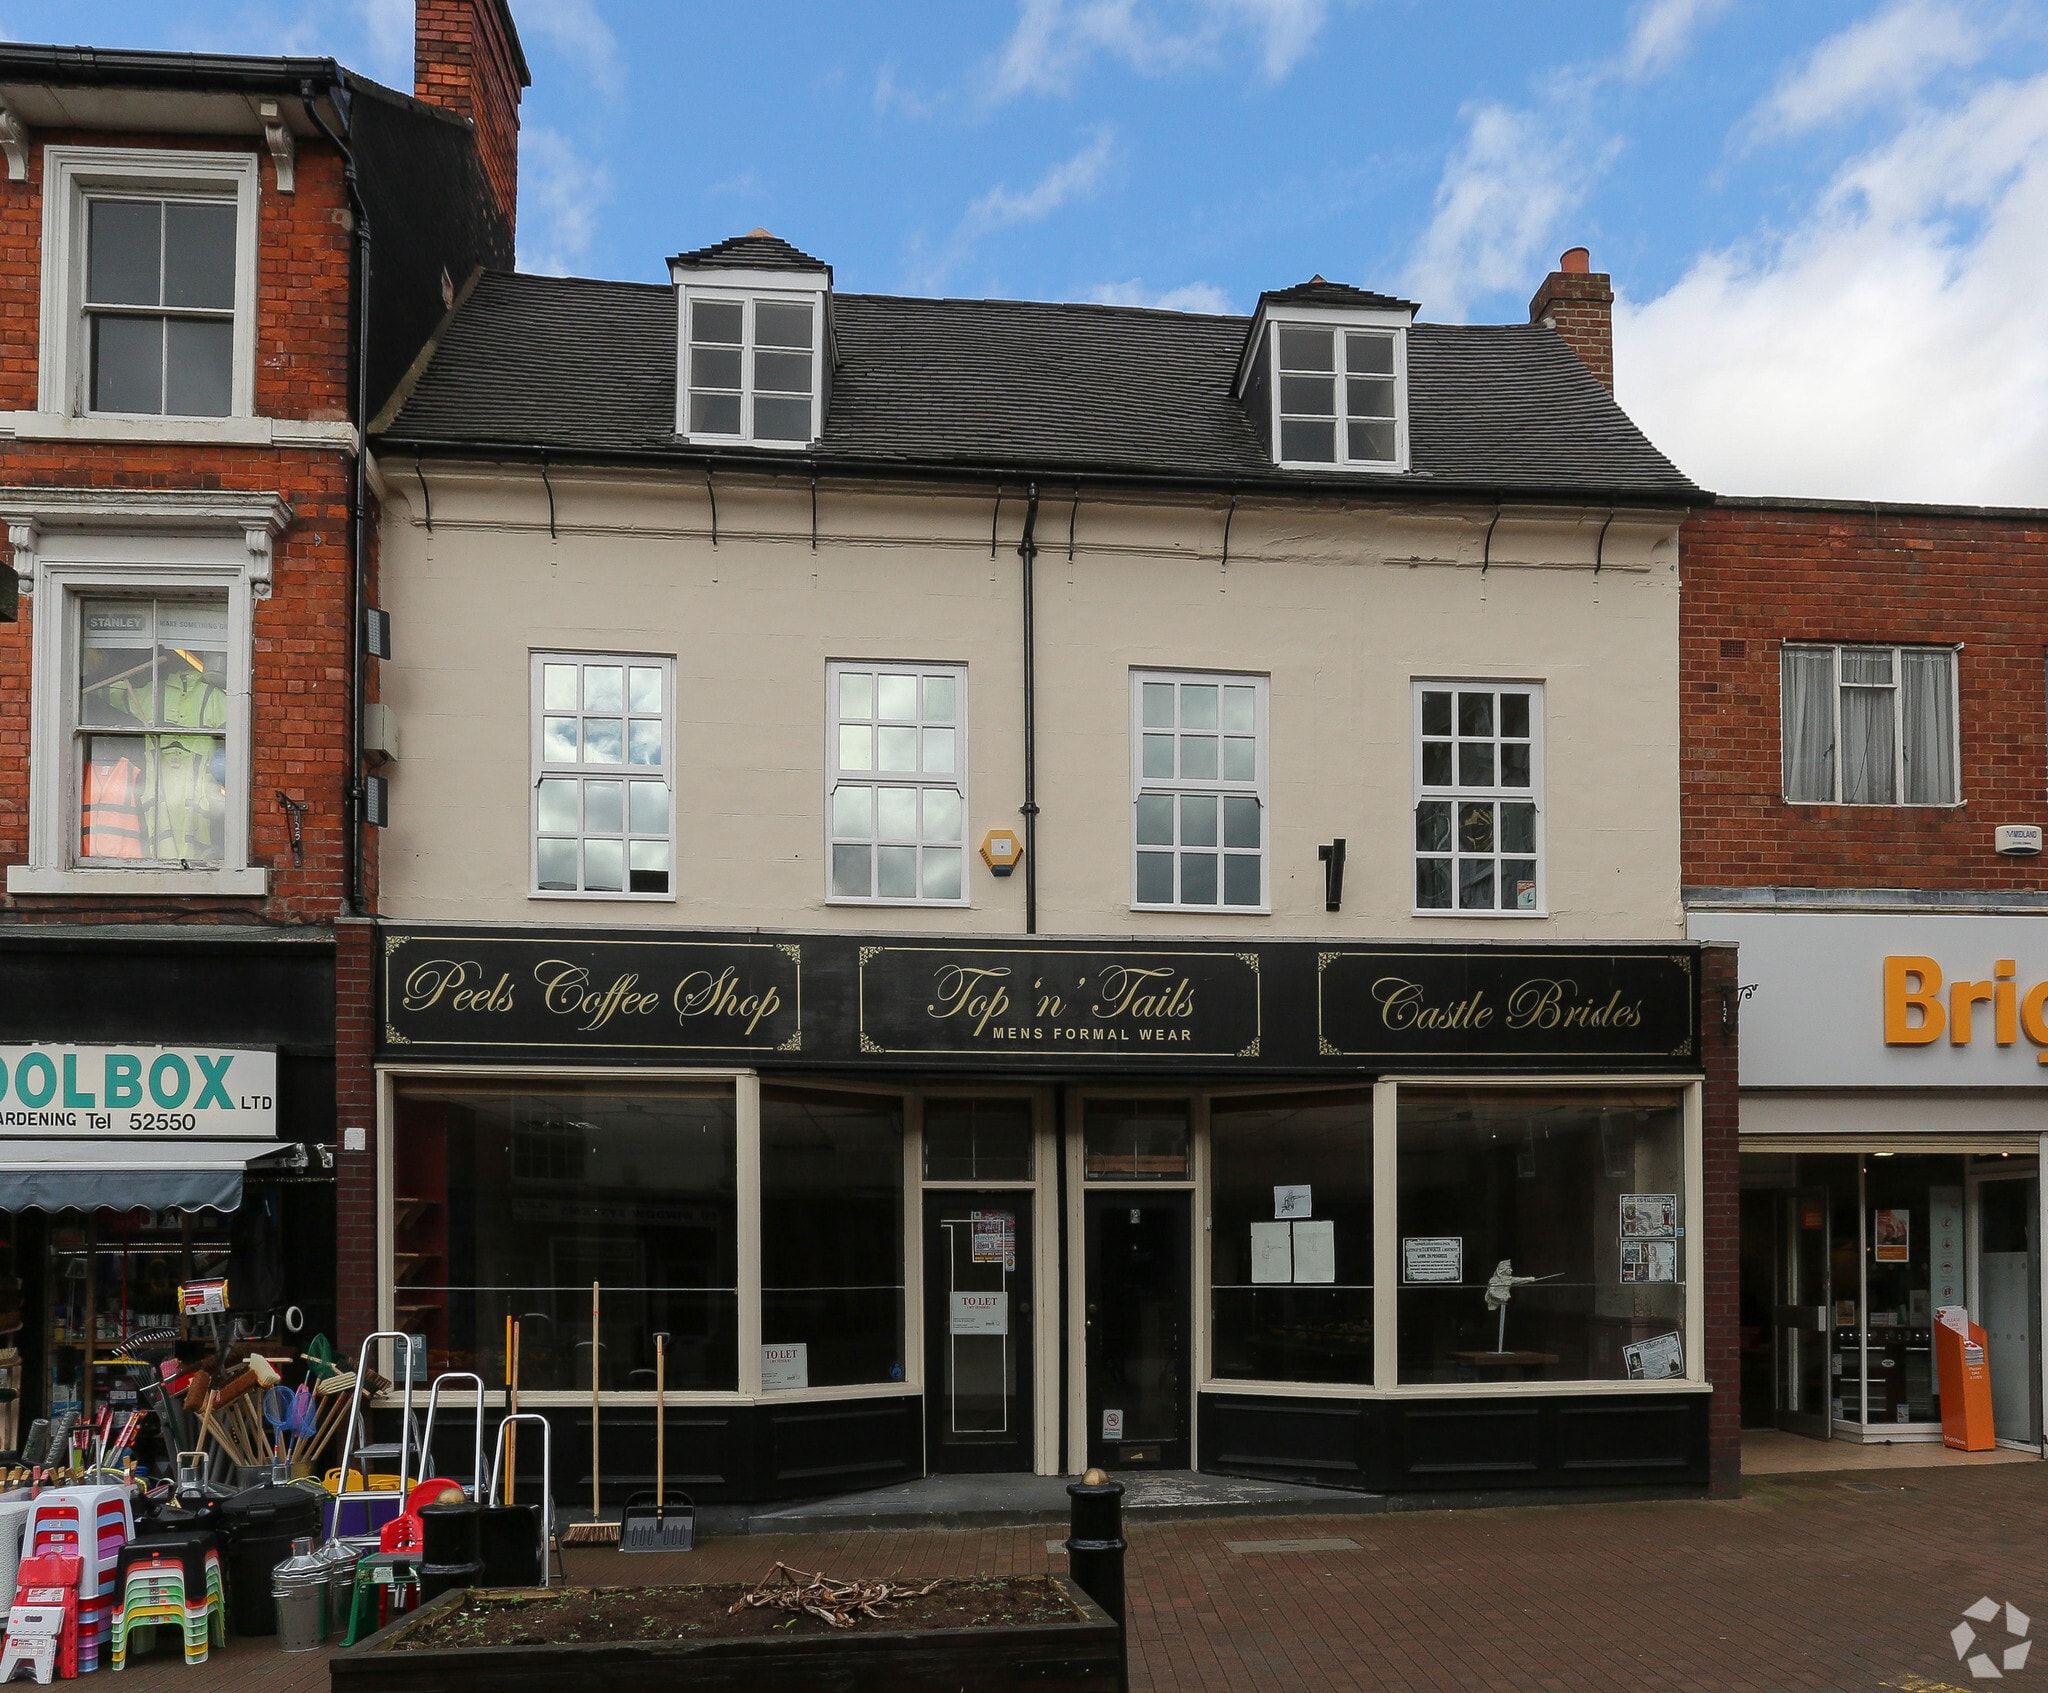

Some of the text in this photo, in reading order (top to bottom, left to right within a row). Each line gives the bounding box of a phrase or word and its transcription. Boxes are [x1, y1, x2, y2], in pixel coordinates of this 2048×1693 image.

[91, 618, 141, 628] STANLEY
[402, 959, 781, 1036] Peels Coffee Shop
[927, 964, 1012, 1037] Top
[1091, 964, 1195, 1018] Tails
[1371, 977, 1643, 1031] Castle Brides
[993, 1027, 1192, 1042] MENS FORMAL WEAR
[0, 1052, 272, 1110] OLBOX LTD
[86, 1112, 111, 1129] Tel
[129, 1113, 196, 1131] 52550
[962, 1297, 998, 1306] TO LET
[765, 1350, 797, 1359] TO LET
